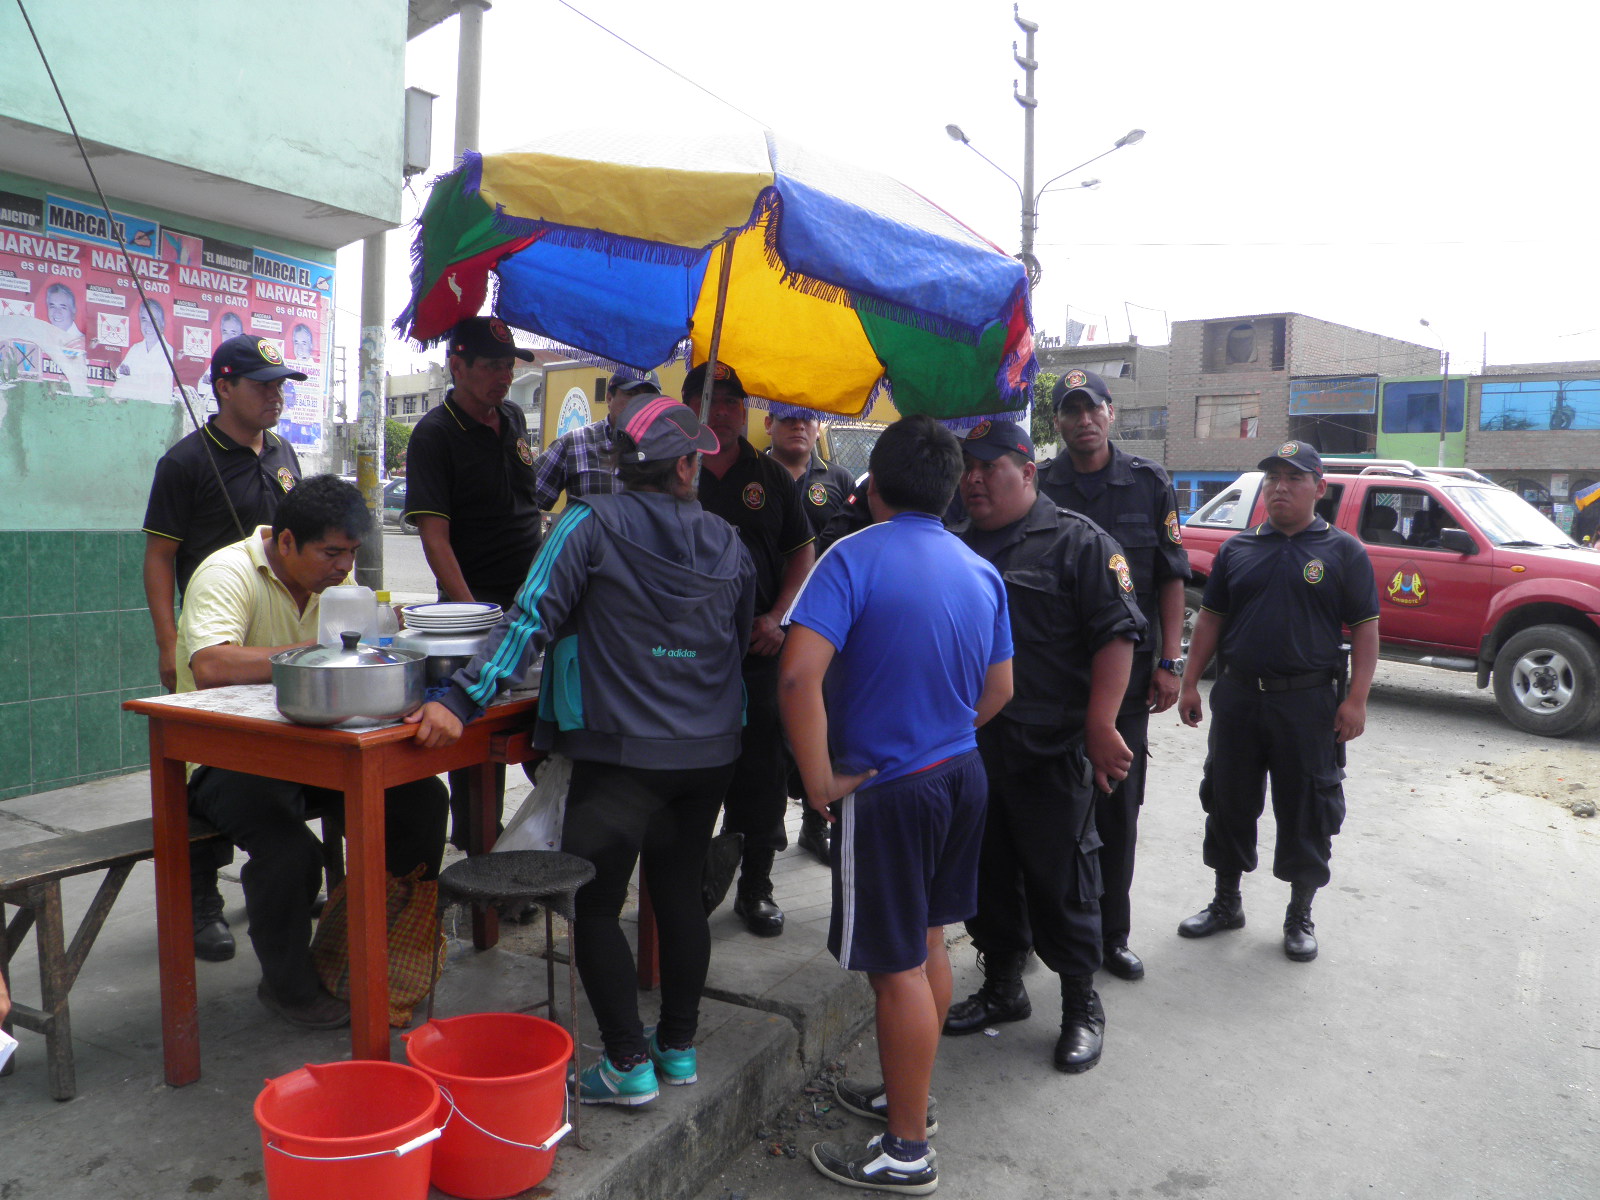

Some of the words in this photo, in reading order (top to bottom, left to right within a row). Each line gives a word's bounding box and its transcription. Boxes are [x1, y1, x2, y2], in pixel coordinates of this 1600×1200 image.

[0, 207, 40, 227] AICITO"
[49, 205, 107, 239] MARCA
[110, 221, 126, 243] EL
[20, 260, 35, 271] es
[37, 261, 48, 274] el
[51, 264, 82, 279] GATO
[253, 256, 296, 284] MARCA
[298, 269, 311, 287] EL
[117, 277, 129, 287] es
[143, 281, 170, 294] GATO
[179, 266, 248, 296] NARVAEZ
[201, 292, 212, 303] es
[214, 293, 223, 304] el
[225, 295, 249, 308] GATO
[255, 281, 317, 307] NARVAEZ
[275, 305, 286, 315] es
[287, 306, 295, 316] el
[296, 308, 318, 320] GATO
[667, 648, 697, 658] adidas
